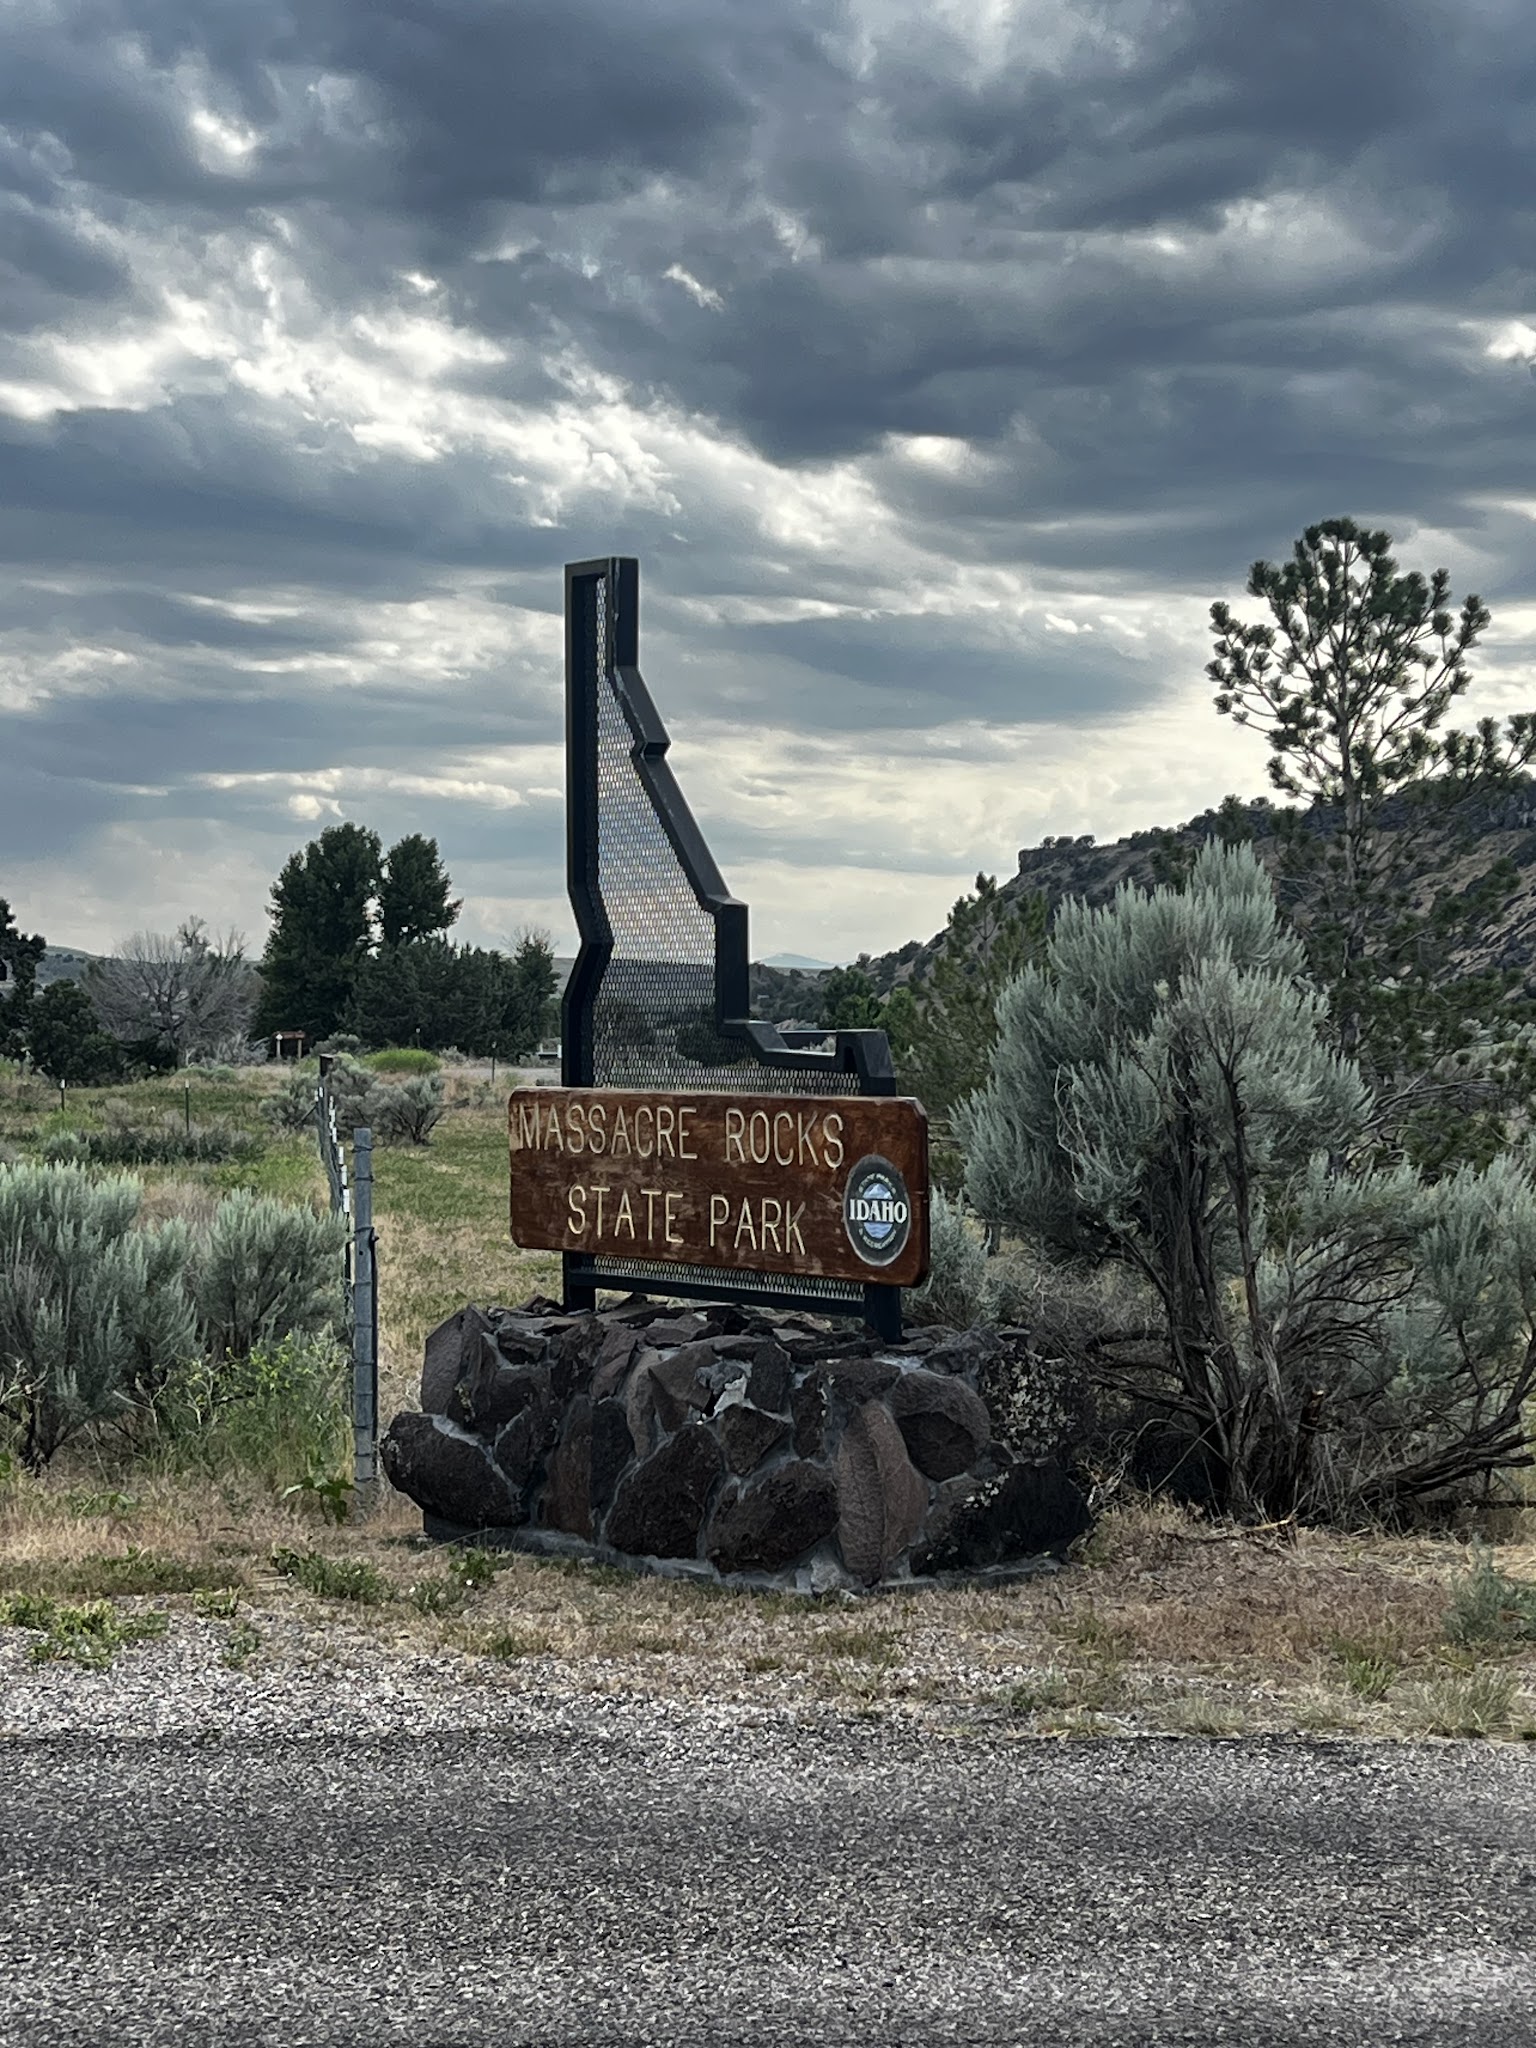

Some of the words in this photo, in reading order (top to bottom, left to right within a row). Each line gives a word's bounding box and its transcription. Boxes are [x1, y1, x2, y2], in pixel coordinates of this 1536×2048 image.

[519, 1102, 698, 1160] MASSACRE
[725, 1107, 844, 1168] ROCKS
[567, 1185, 684, 1244] STATE
[710, 1194, 805, 1255] PARK
[849, 1198, 908, 1224] IDAHO
